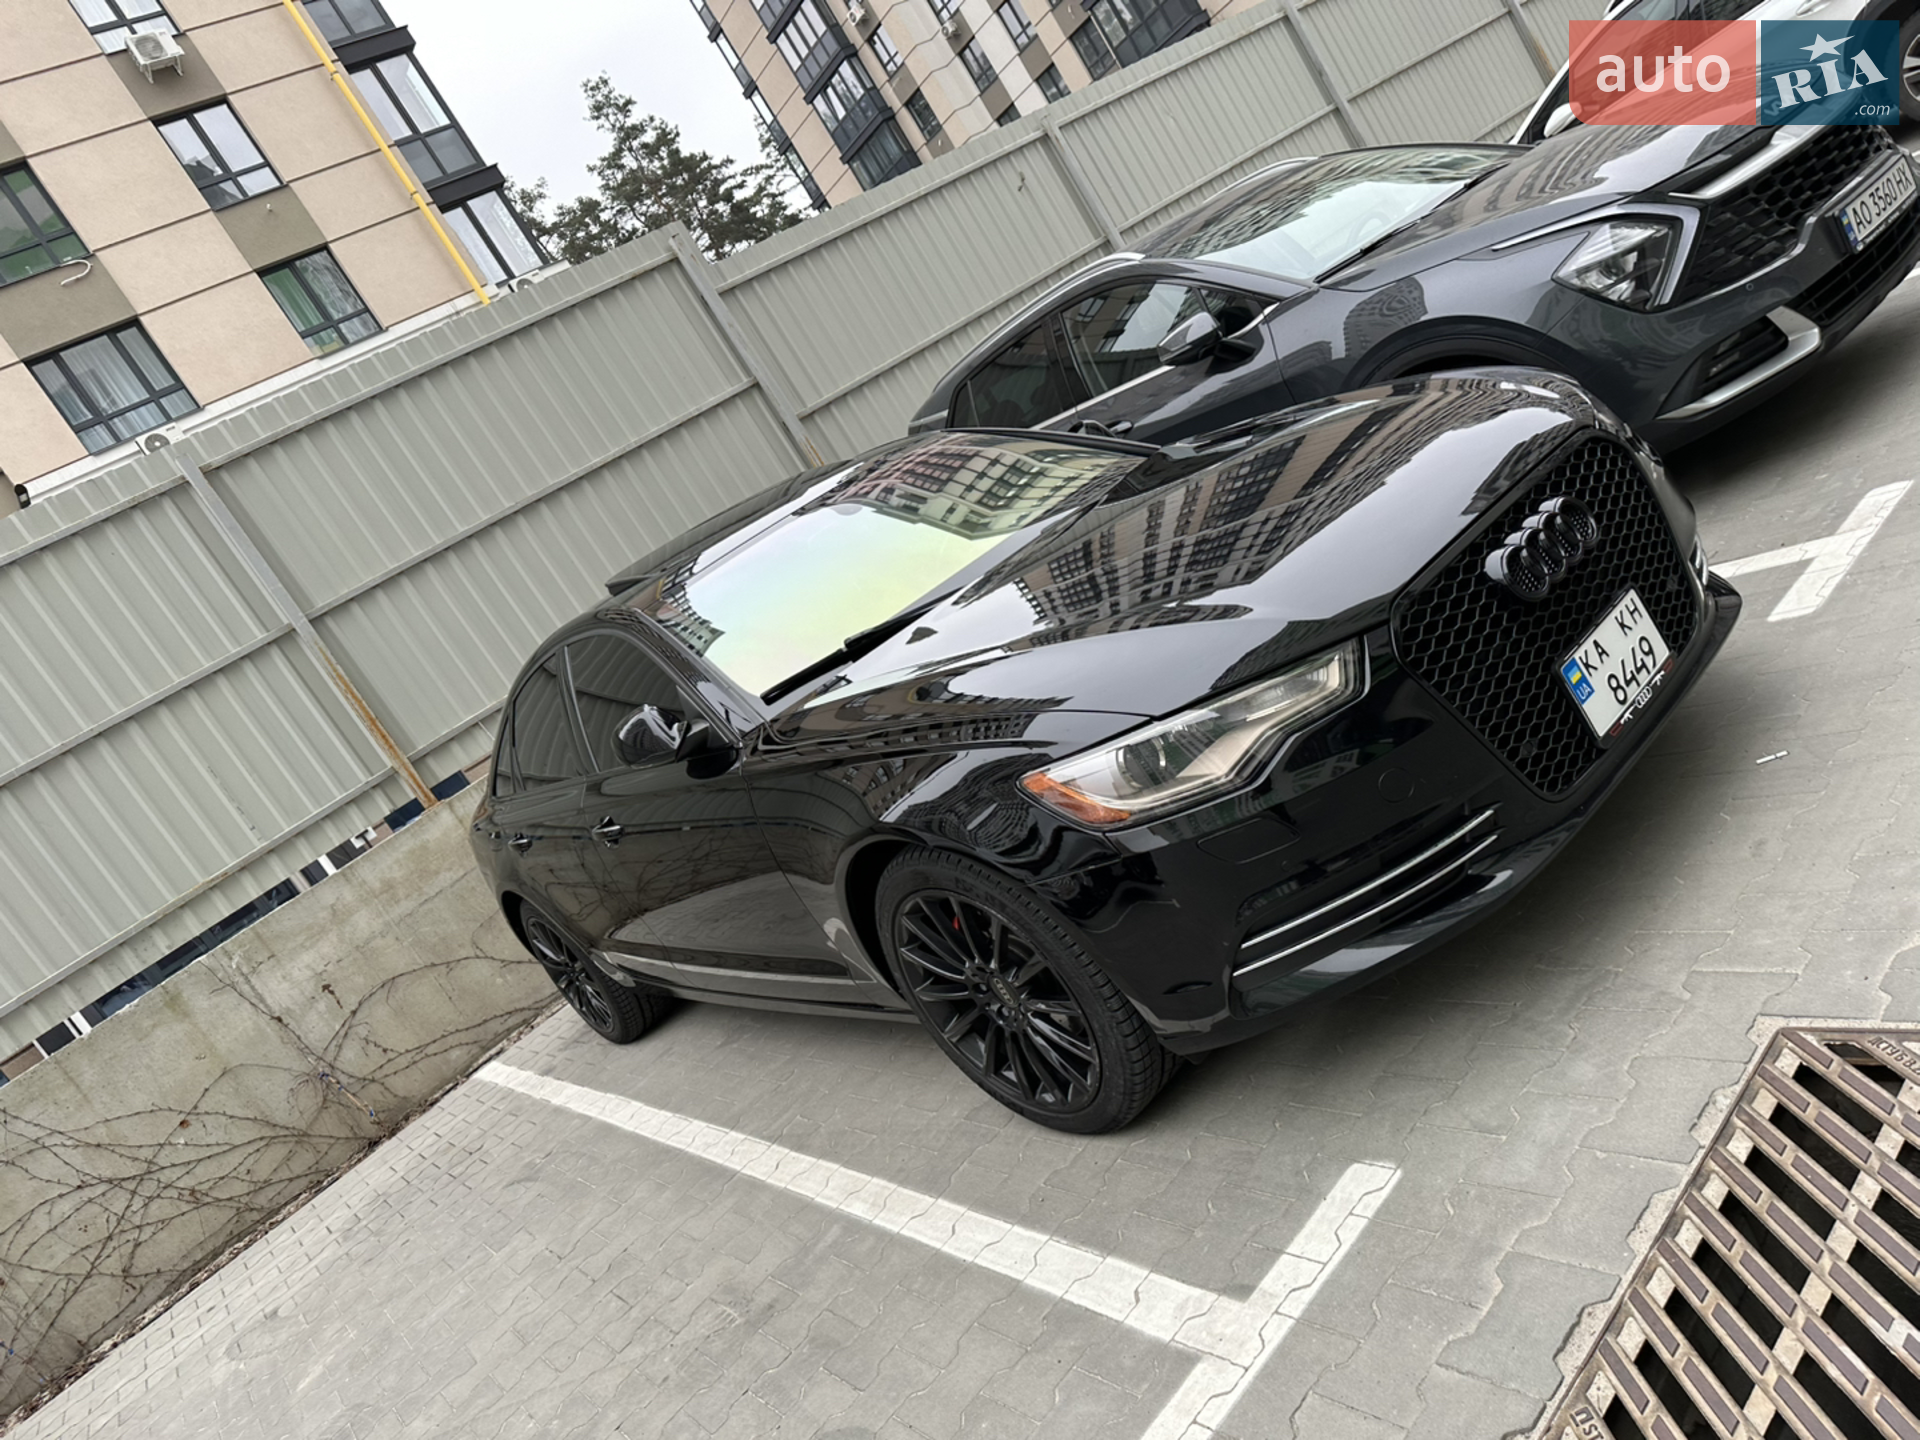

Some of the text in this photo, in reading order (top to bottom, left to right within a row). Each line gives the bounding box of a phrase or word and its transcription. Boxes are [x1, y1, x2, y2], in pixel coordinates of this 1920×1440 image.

[1851, 200, 1872, 233] AO
[1868, 177, 1898, 217] 3560
[1892, 163, 1912, 196] HX
[1578, 597, 1643, 677] KA KH
[1607, 635, 1657, 706] 8449
[1576, 683, 1592, 700] UA
